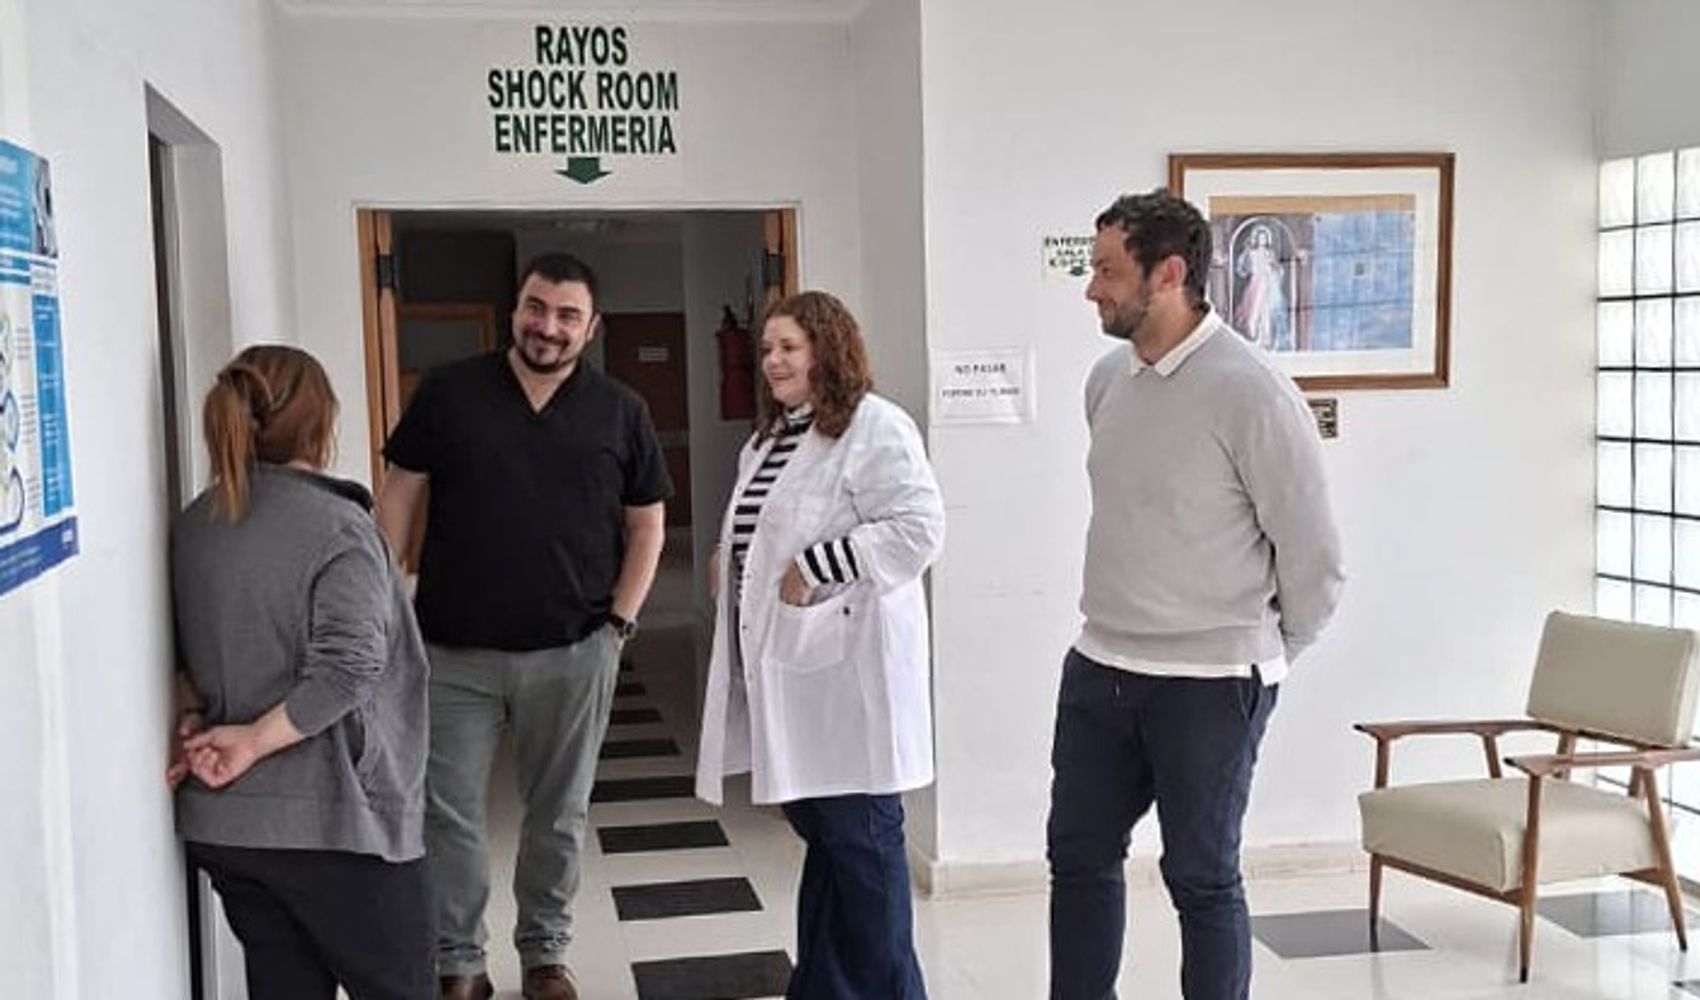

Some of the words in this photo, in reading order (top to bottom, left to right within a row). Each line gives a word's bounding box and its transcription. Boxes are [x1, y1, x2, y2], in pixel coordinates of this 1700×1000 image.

[535, 26, 628, 66] RAYOS
[487, 69, 588, 110] SHOCK
[597, 71, 679, 111] ROOM
[495, 114, 676, 154] ENFERMERIA
